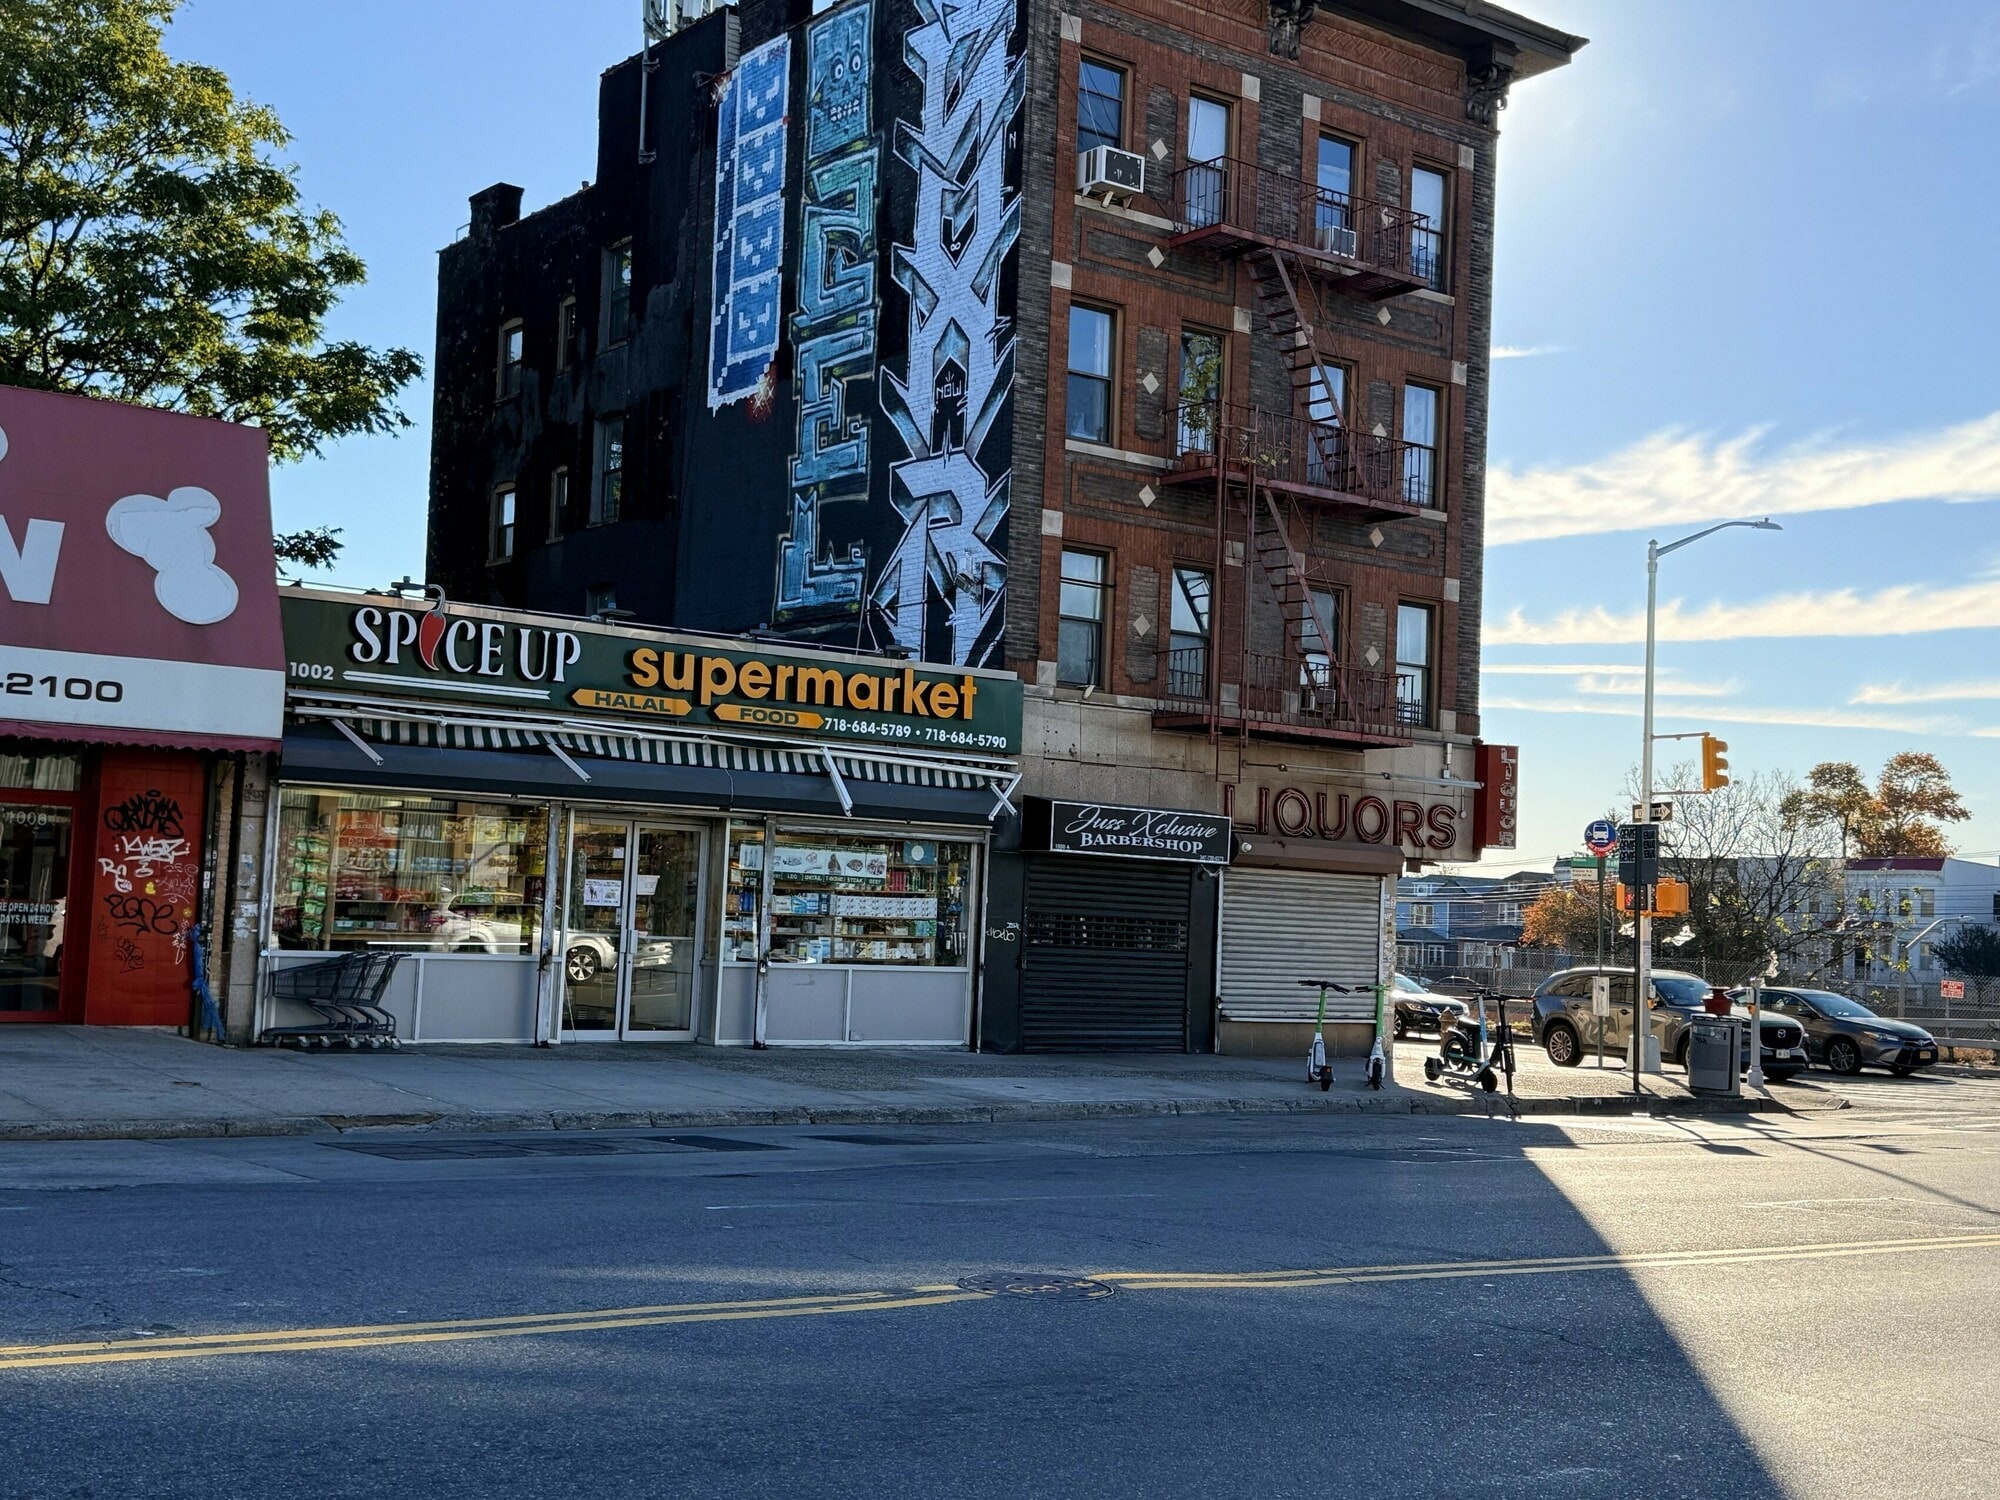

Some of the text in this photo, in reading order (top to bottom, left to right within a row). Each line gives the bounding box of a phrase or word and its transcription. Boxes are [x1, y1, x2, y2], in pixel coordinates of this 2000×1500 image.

[519, 628, 581, 682] UP
[290, 662, 334, 680] 1002
[632, 648, 978, 719] supermarket
[595, 692, 671, 713] HALAL
[740, 708, 799, 725] FOOD
[825, 717, 1007, 749] 718-684-5789 718-684-5790
[1065, 806, 1218, 839] Juss Xclusive
[1224, 784, 1457, 849] LIQUORS
[1080, 832, 1203, 854] BARBERSHOP
[0, 913, 49, 925] DAYS A WEEK
[8, 902, 28, 912] OPEN
[29, 903, 39, 914] 24
